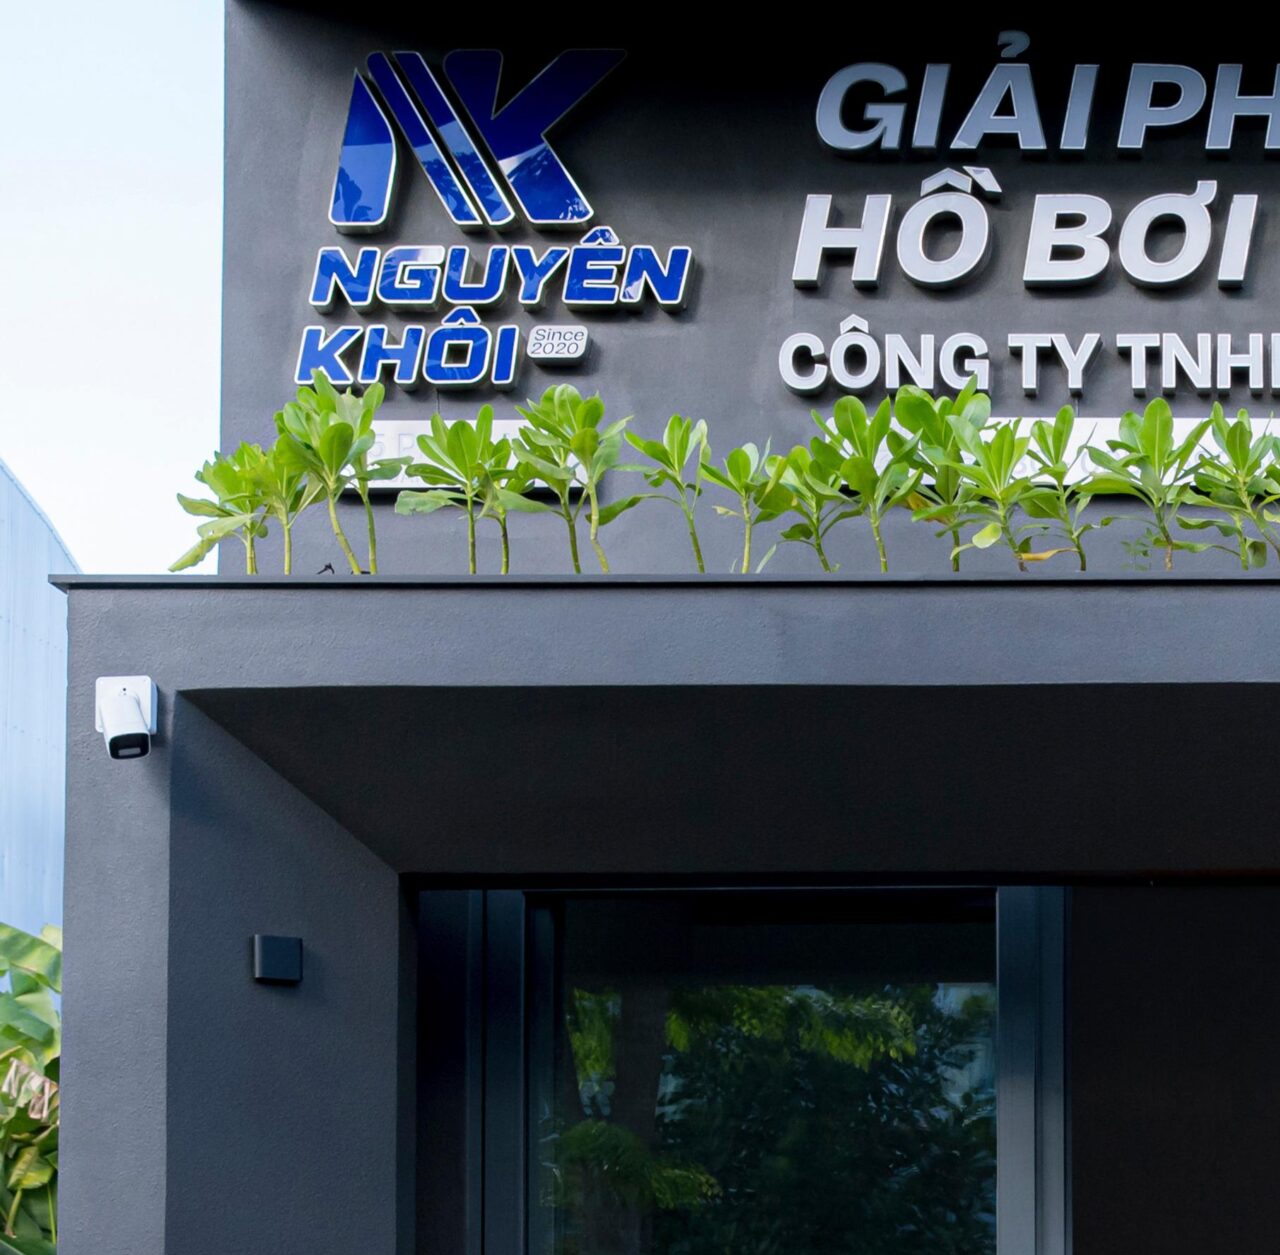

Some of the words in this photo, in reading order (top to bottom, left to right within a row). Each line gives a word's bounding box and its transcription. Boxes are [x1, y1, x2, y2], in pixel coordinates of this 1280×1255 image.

[816, 30, 1100, 153] GIẢI
[309, 226, 697, 310] NGUYÊN
[791, 165, 1003, 290] HỒ
[1022, 179, 1259, 290] BƠI
[294, 305, 521, 388] KHÔI
[530, 342, 580, 355] 2020
[533, 327, 585, 342] Since
[778, 313, 991, 394] CÔNG
[1007, 332, 1102, 396] TY
